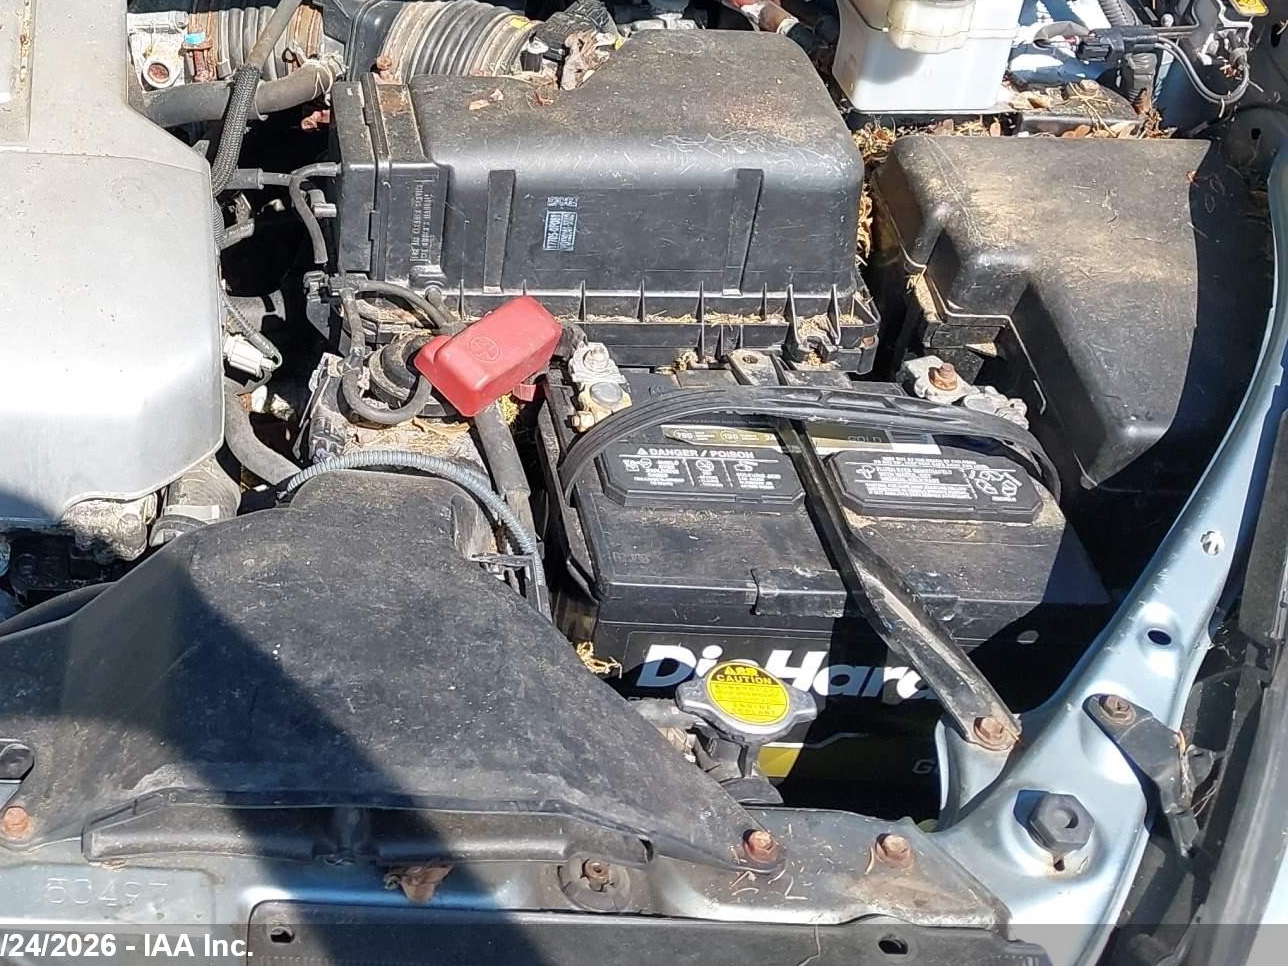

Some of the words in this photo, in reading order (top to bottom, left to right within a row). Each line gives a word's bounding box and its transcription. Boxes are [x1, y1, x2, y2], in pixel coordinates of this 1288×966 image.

[649, 448, 699, 457] DANGER
[710, 450, 755, 459] POISON
[637, 644, 939, 699] DiHar
[716, 674, 772, 685] CAUTION
